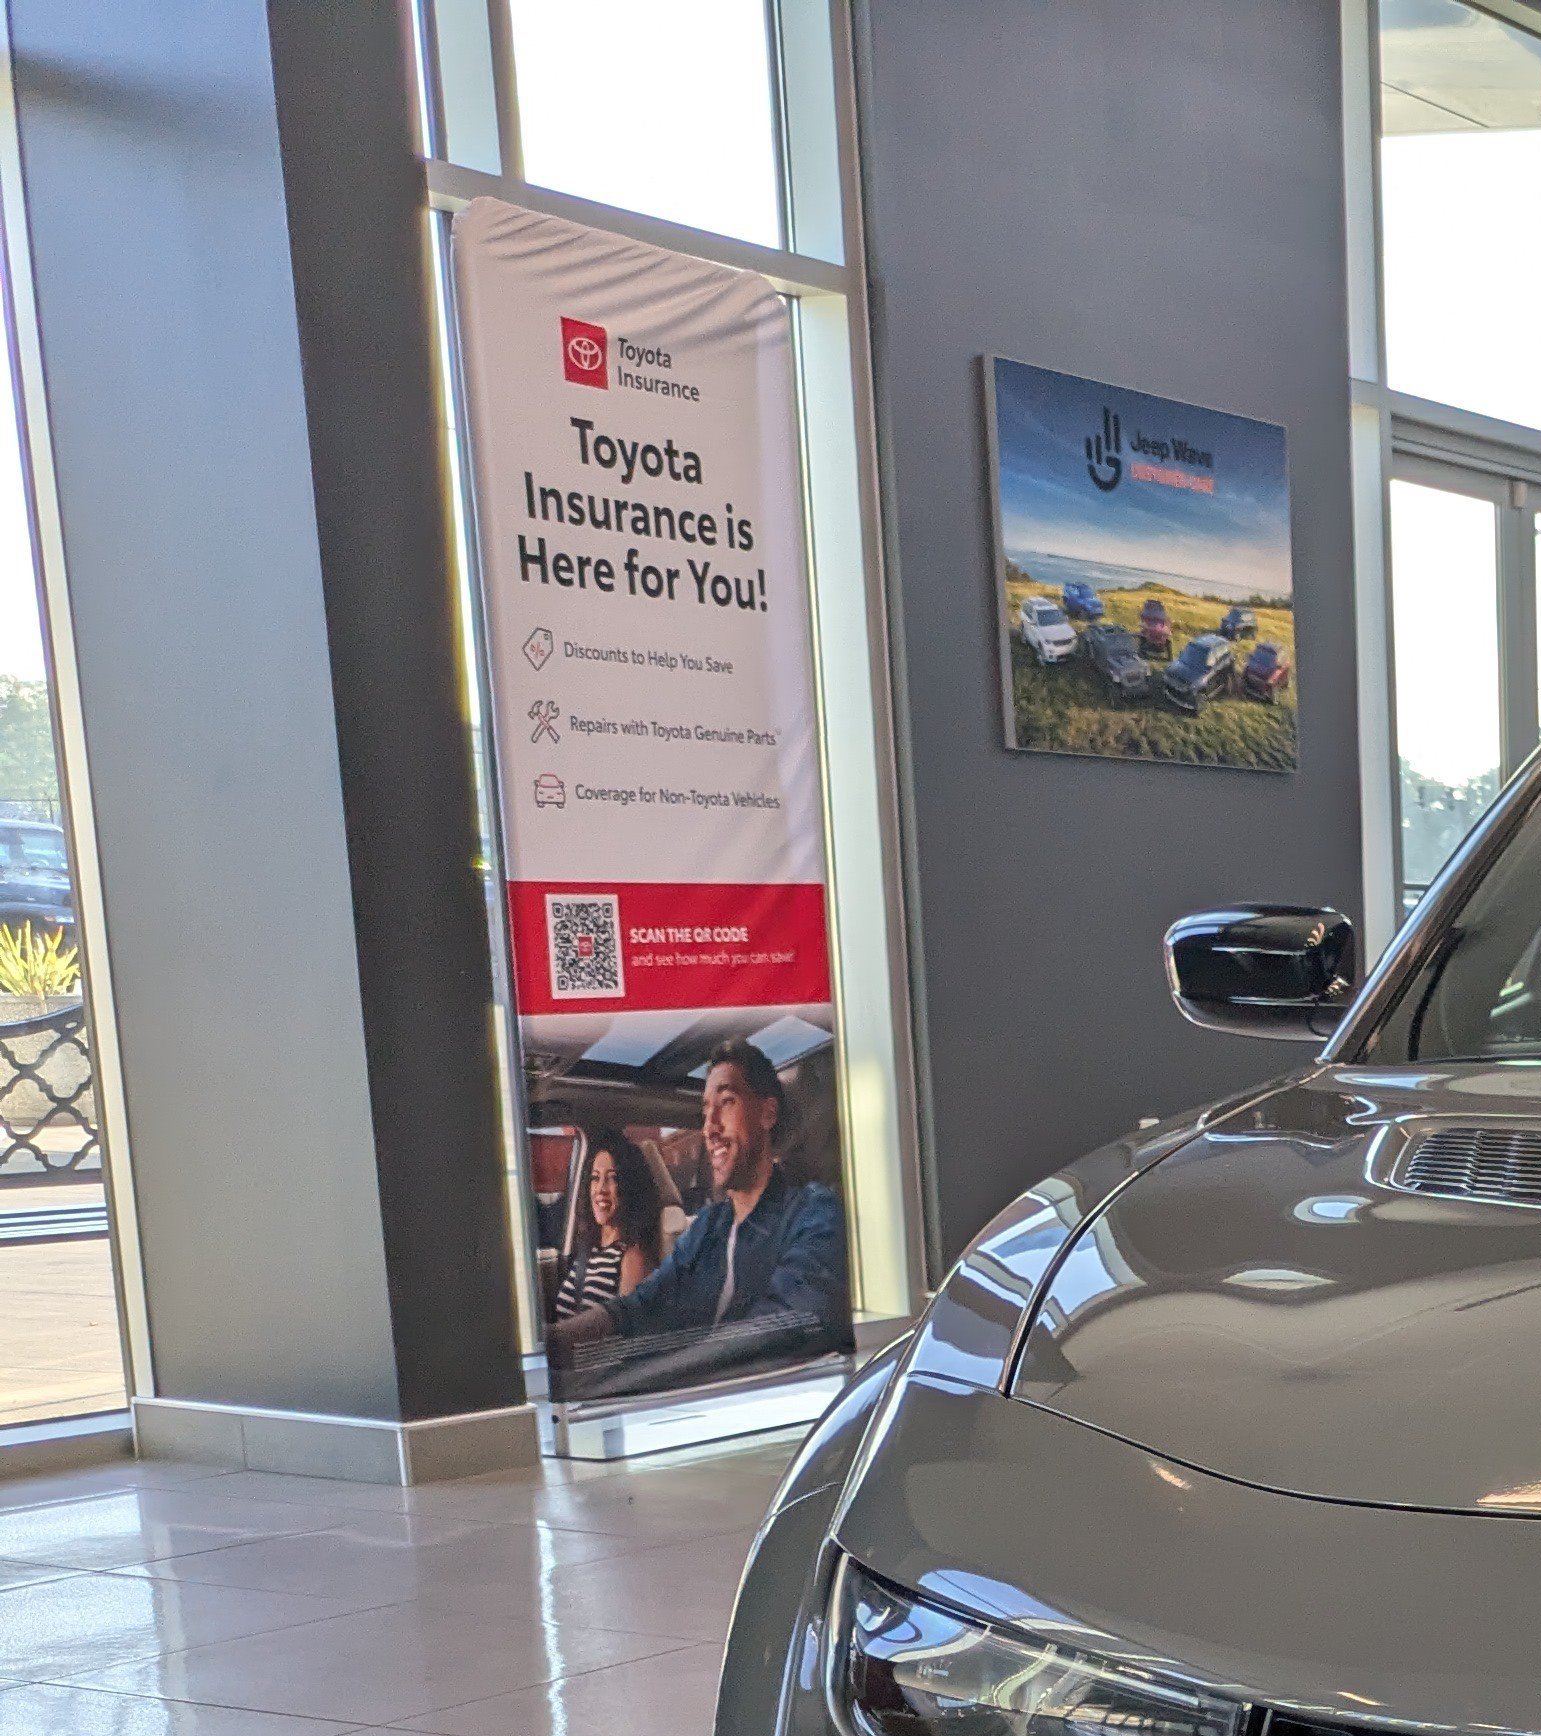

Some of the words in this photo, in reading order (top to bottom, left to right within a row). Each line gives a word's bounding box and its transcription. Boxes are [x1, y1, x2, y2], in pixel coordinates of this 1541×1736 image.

[618, 337, 672, 369] Toyota
[618, 366, 700, 402] Insurance
[570, 416, 703, 485] Toyota
[1130, 431, 1169, 462] Jeep
[524, 471, 718, 546] Insurance
[726, 503, 754, 551] is
[518, 534, 615, 592] Here
[624, 548, 680, 600] for
[687, 558, 767, 612] You!
[564, 641, 628, 663] Discounts
[631, 649, 645, 665] to
[648, 650, 678, 669] Help
[680, 653, 703, 671] You
[706, 657, 733, 674] Save
[570, 716, 618, 735] Repairs
[621, 719, 648, 736] with
[651, 722, 691, 741] Toyota
[694, 725, 744, 744] Genuine
[575, 784, 636, 805] Coverage
[639, 787, 656, 803] for
[660, 788, 730, 809] Non-Toyota
[732, 791, 780, 809] Vehicles
[629, 927, 667, 944] SCAN
[667, 927, 693, 943] THE
[693, 927, 712, 943] QR
[713, 926, 749, 943] CODE
[631, 953, 653, 967] and
[675, 952, 698, 966] how
[699, 950, 730, 966] much
